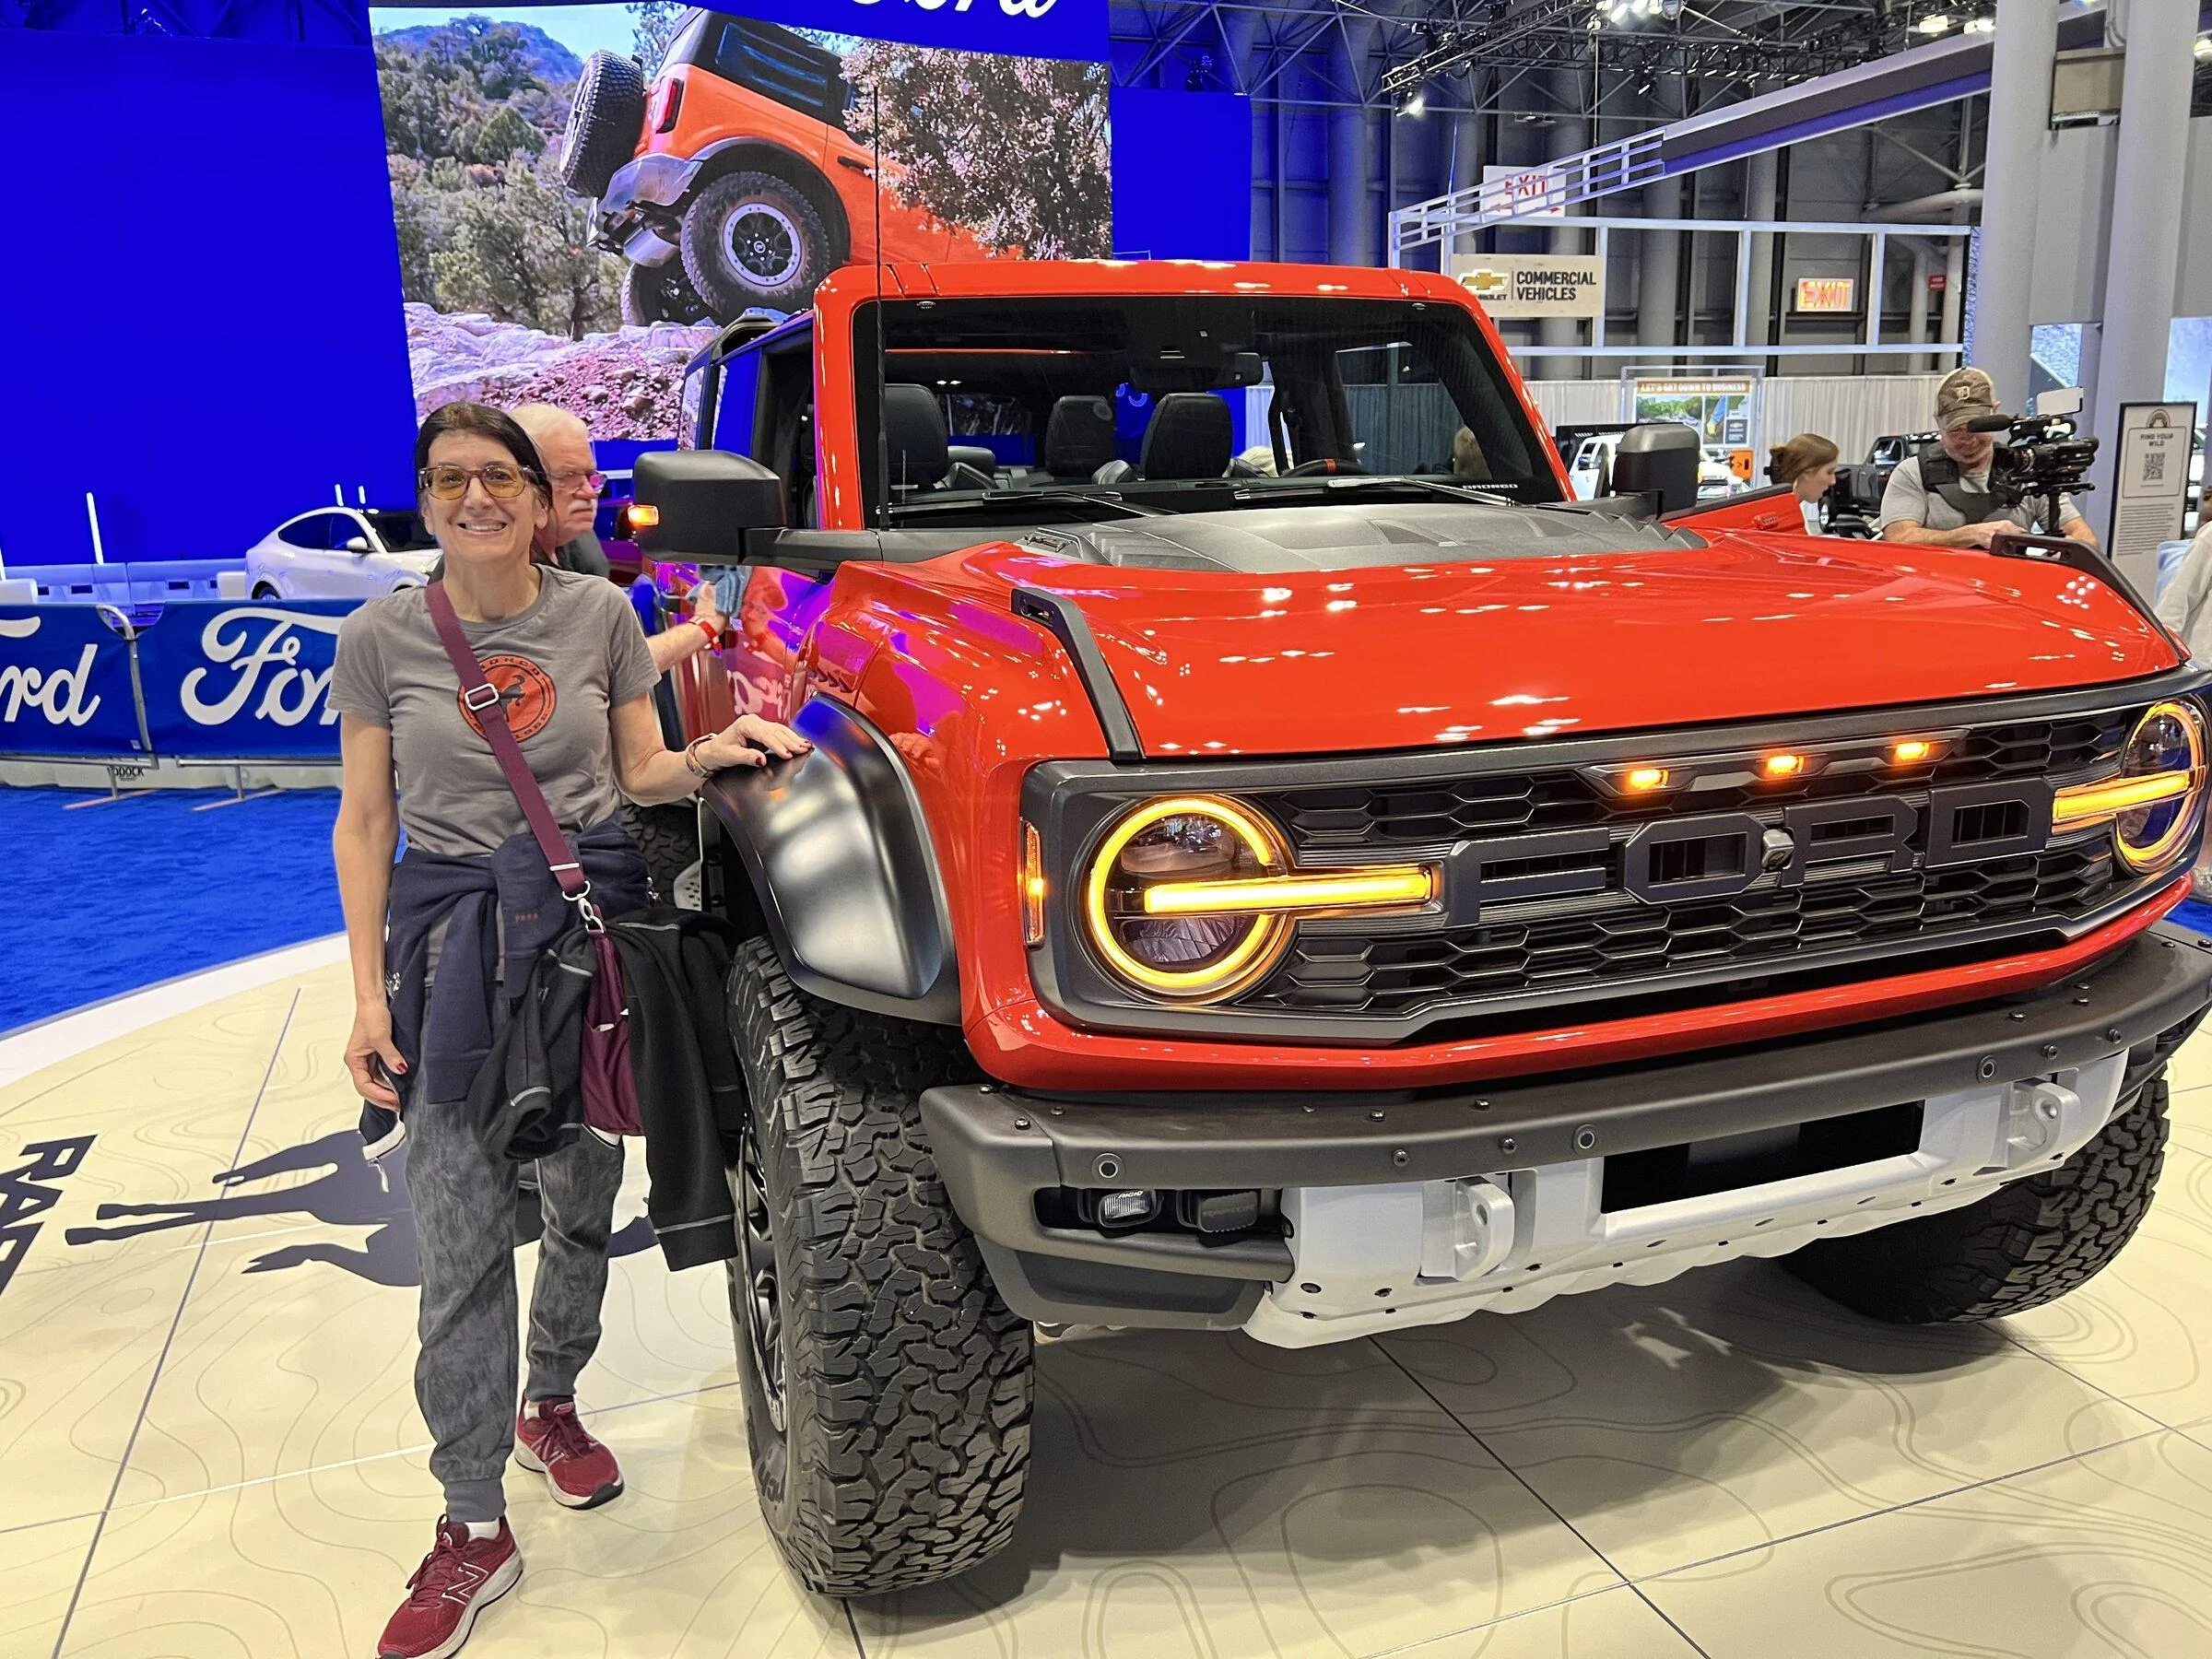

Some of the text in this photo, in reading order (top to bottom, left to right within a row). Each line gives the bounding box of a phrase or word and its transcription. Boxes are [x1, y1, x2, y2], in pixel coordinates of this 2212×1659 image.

[1516, 271, 1597, 286] COMMERCIAL
[1516, 287, 1577, 301] VEHICLES
[1799, 280, 1852, 310] EXIT
[1448, 777, 2053, 925] FORD
